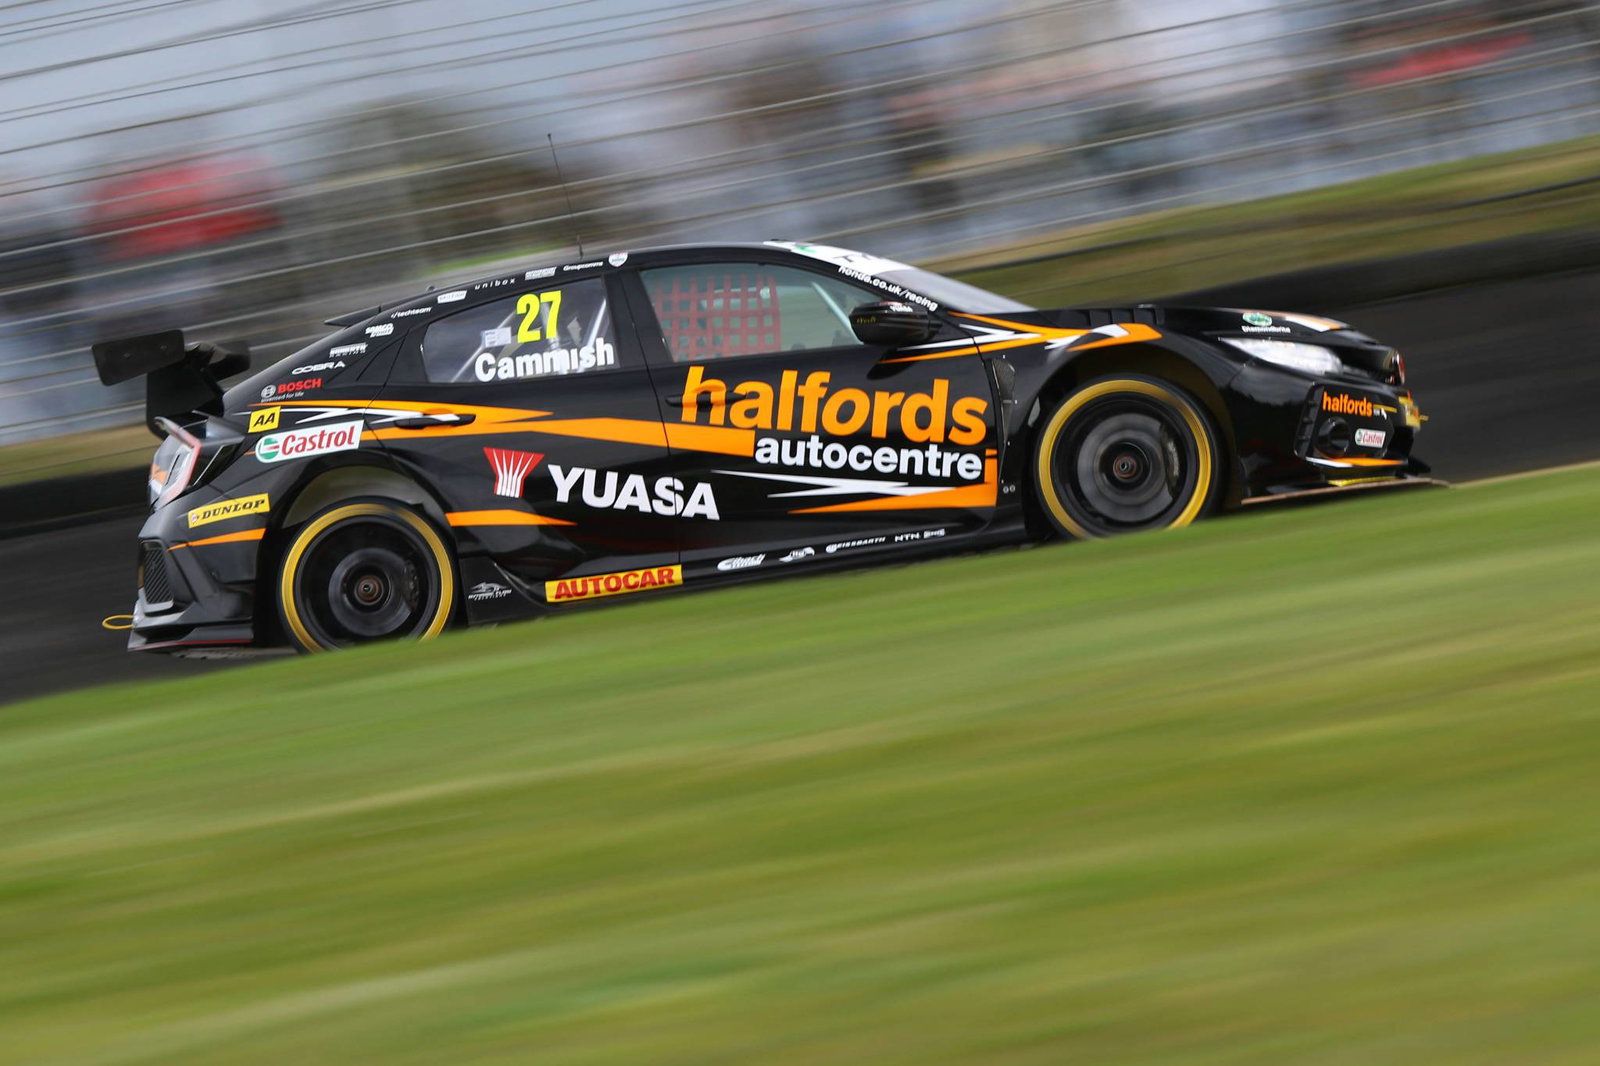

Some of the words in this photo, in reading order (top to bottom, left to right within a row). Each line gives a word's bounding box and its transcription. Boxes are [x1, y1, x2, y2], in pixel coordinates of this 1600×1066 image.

[474, 278, 516, 290] unibox
[838, 265, 938, 312] honda.co.uk/racing
[516, 290, 562, 343] 27
[291, 360, 346, 375] COBRA
[475, 337, 615, 382] Cammish
[277, 378, 322, 394] BOSCH
[252, 412, 276, 428] AA
[681, 366, 988, 445] halfords
[1322, 391, 1373, 418] halfords
[281, 425, 356, 456] Castrol
[754, 435, 982, 480] autocentre
[547, 464, 720, 521] YUASA
[201, 499, 266, 520] DUNLOP
[894, 532, 920, 542] NTN
[555, 567, 676, 600] AUTOCAR
